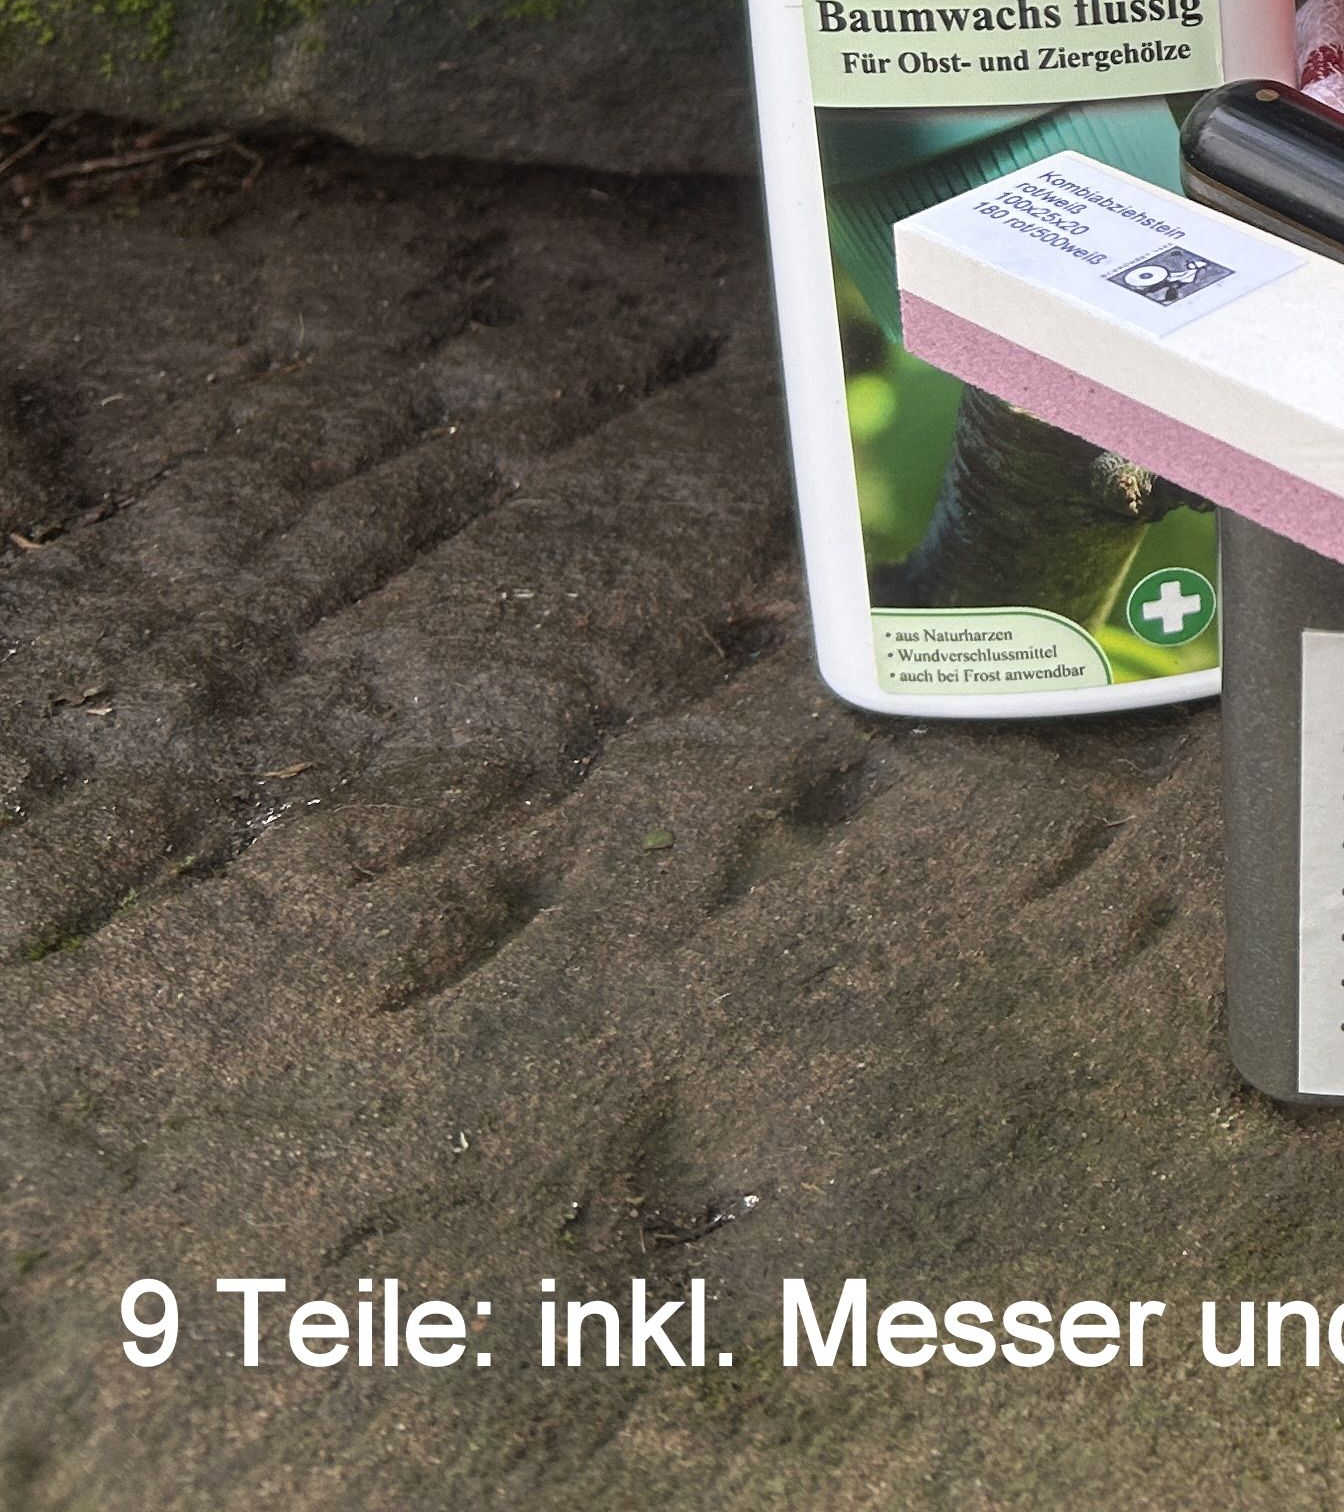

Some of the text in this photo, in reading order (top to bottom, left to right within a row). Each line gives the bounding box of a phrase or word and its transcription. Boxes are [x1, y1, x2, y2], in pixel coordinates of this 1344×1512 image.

[841, 41, 1191, 74] Für Obst- und Ziergehölze
[973, 201, 1009, 220] 180
[1016, 181, 1087, 215] rot/weiß
[1038, 171, 1186, 240] Kombiabziehstein
[995, 192, 1089, 235] 100x25x20
[896, 629, 1013, 642] aus Naturharzen
[898, 646, 1058, 661] Wundverschlussmittel
[900, 664, 1086, 682] auch bei Frost anwendbar
